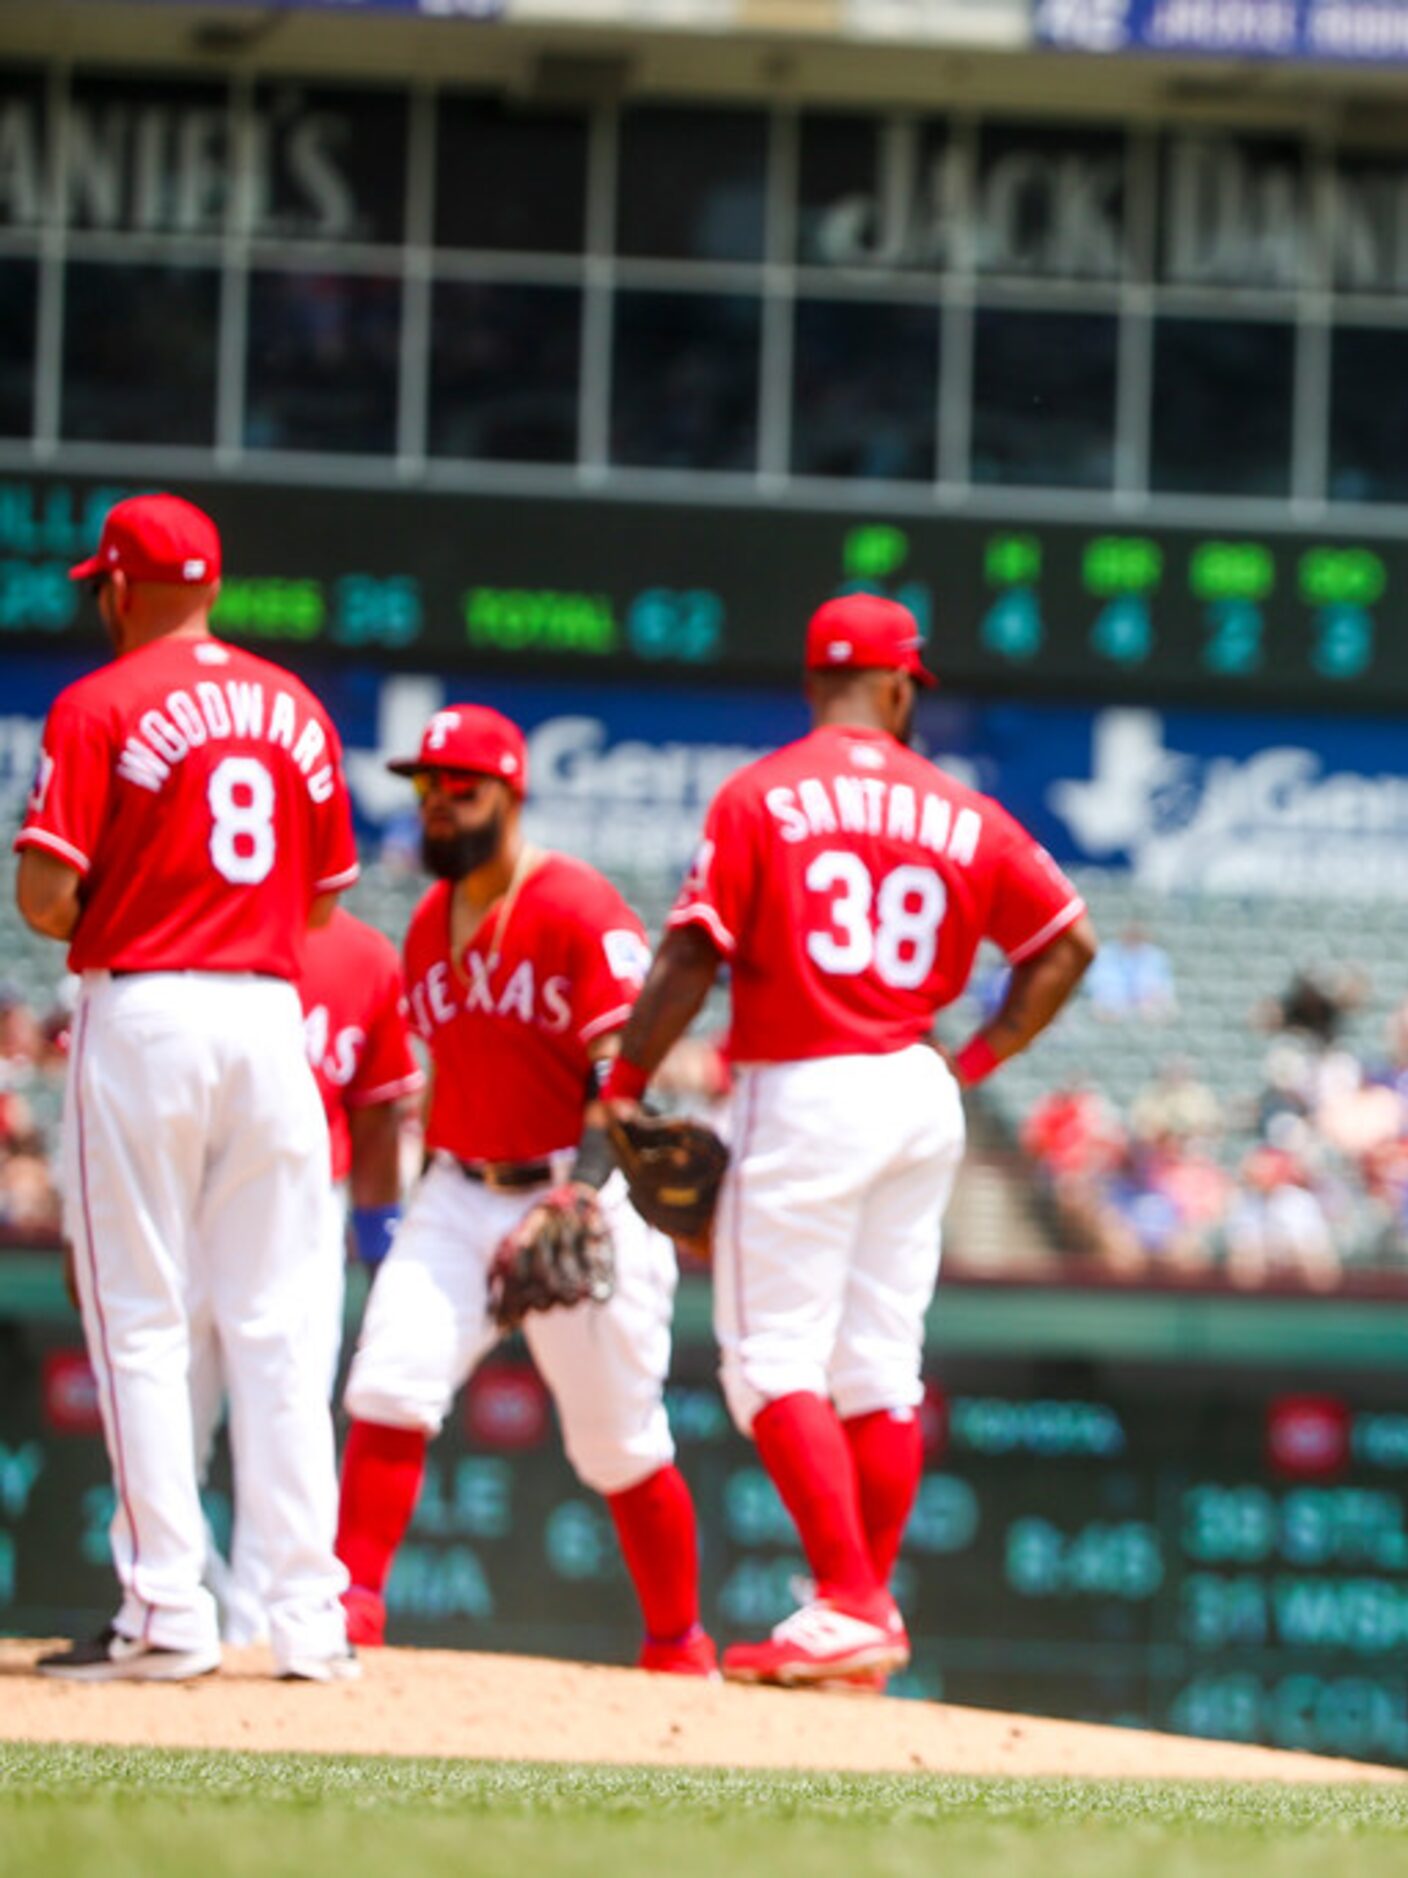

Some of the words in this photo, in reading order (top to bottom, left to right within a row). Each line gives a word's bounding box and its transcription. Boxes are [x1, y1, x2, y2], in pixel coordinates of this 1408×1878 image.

[426, 711, 461, 749] T
[208, 757, 276, 885] 8
[766, 776, 982, 867] SANTANA
[806, 850, 947, 989] 38
[398, 948, 573, 1039] TEXAS
